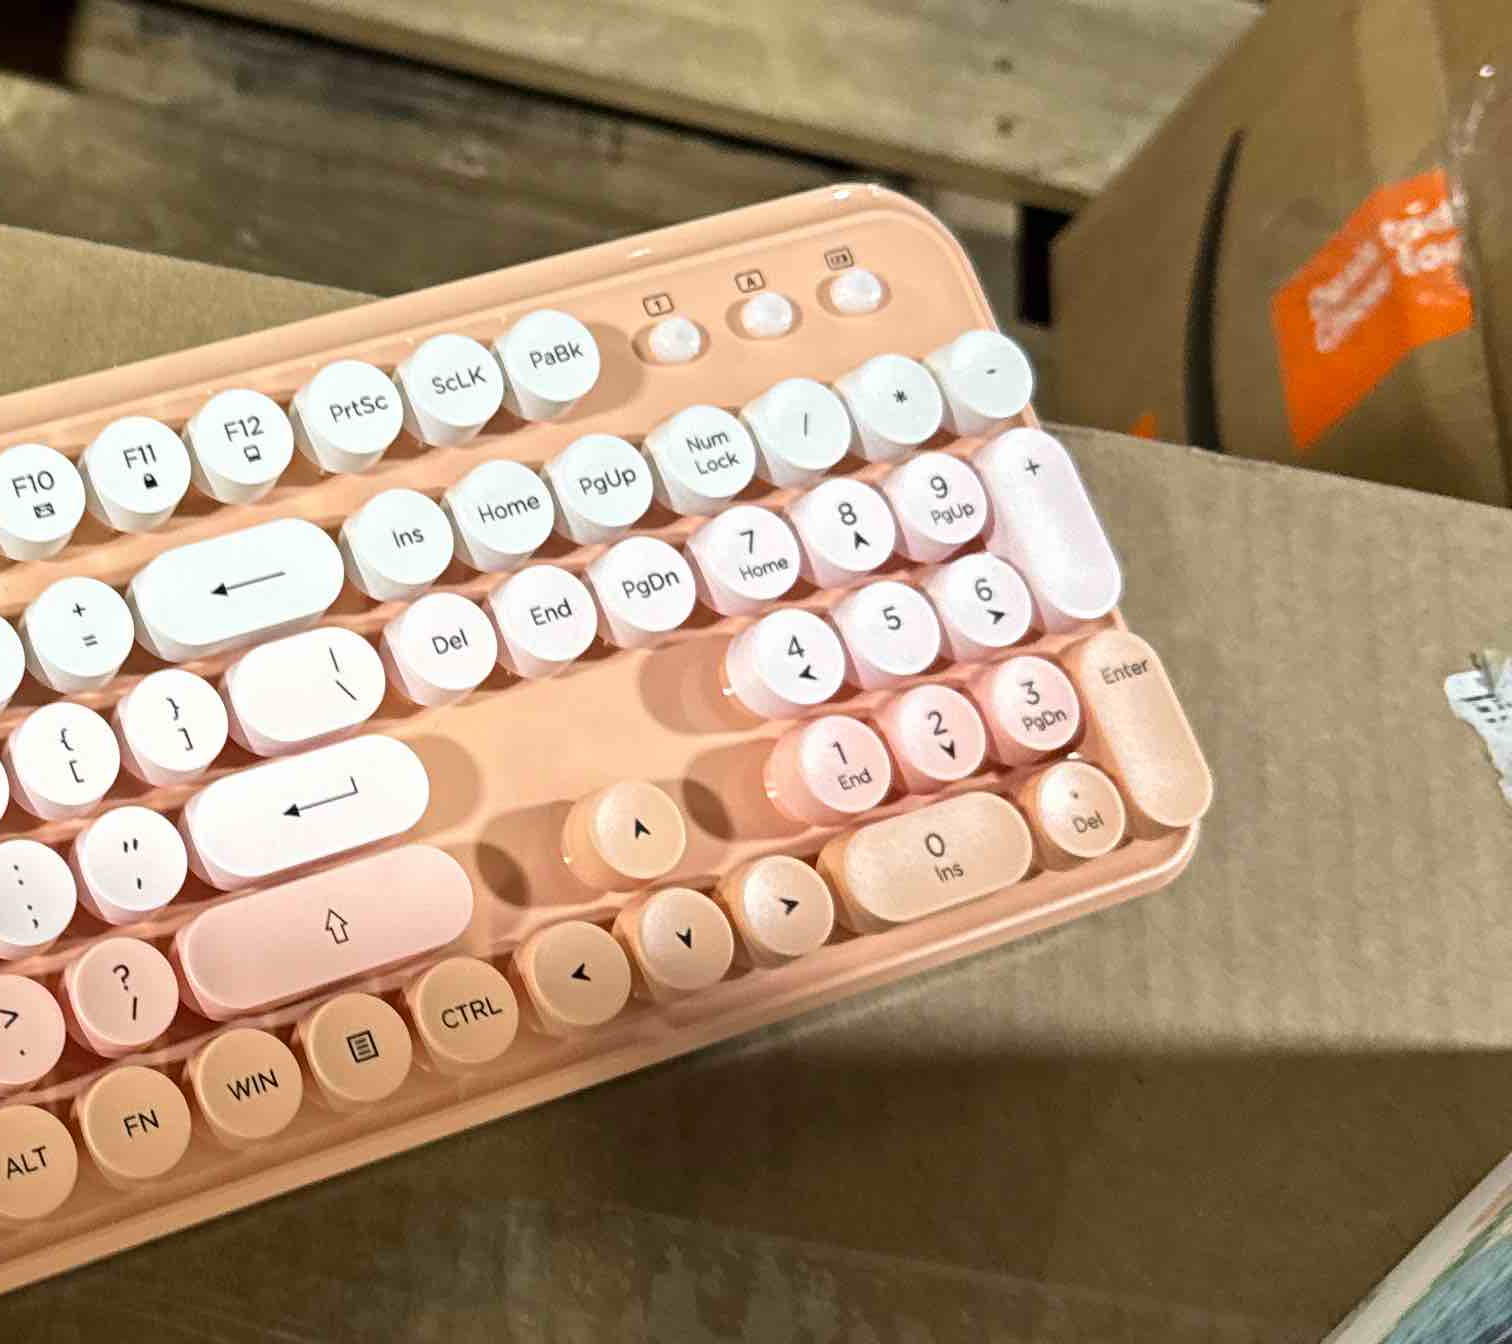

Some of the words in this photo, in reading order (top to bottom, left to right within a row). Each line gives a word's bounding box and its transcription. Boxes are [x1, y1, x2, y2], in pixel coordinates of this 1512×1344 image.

[329, 395, 389, 423] PrtSc
[223, 415, 265, 442] F12
[685, 431, 729, 452] Num
[122, 443, 157, 469] F11
[694, 451, 740, 475] Lock
[1025, 459, 1041, 476] +
[11, 470, 55, 498] F10
[579, 468, 637, 495] PgUp
[930, 475, 949, 499] 9
[478, 495, 540, 524] Home
[837, 501, 858, 527] 8
[930, 503, 975, 525] PgUp
[392, 528, 425, 549] Ins
[739, 529, 755, 555] 7
[738, 557, 789, 581] Home
[621, 571, 680, 599] PgDn
[974, 577, 993, 602] 6
[72, 603, 86, 617] +
[530, 597, 573, 626] End
[882, 605, 902, 631] 5
[82, 634, 99, 647] =
[431, 628, 469, 655] Del
[787, 635, 805, 658] 4
[1101, 659, 1148, 685] Enter
[335, 680, 357, 701] \
[1021, 680, 1041, 706] 3
[166, 697, 180, 721] }
[1021, 709, 1068, 732] PgDn
[927, 710, 949, 737] 2
[60, 727, 74, 752] {
[178, 727, 194, 751] ]
[832, 741, 848, 765] 1
[68, 759, 85, 784] [
[837, 767, 873, 791] End
[1072, 810, 1105, 834] Del
[924, 832, 946, 858] 0
[13, 864, 24, 886] :
[934, 863, 965, 883] Ins
[27, 904, 39, 929] ;
[112, 964, 130, 991] ?
[0, 1009, 19, 1029] >
[441, 997, 503, 1029] CTRL
[226, 1068, 279, 1102] WIN
[123, 1109, 160, 1138] FN
[4, 1145, 49, 1180] ALT
